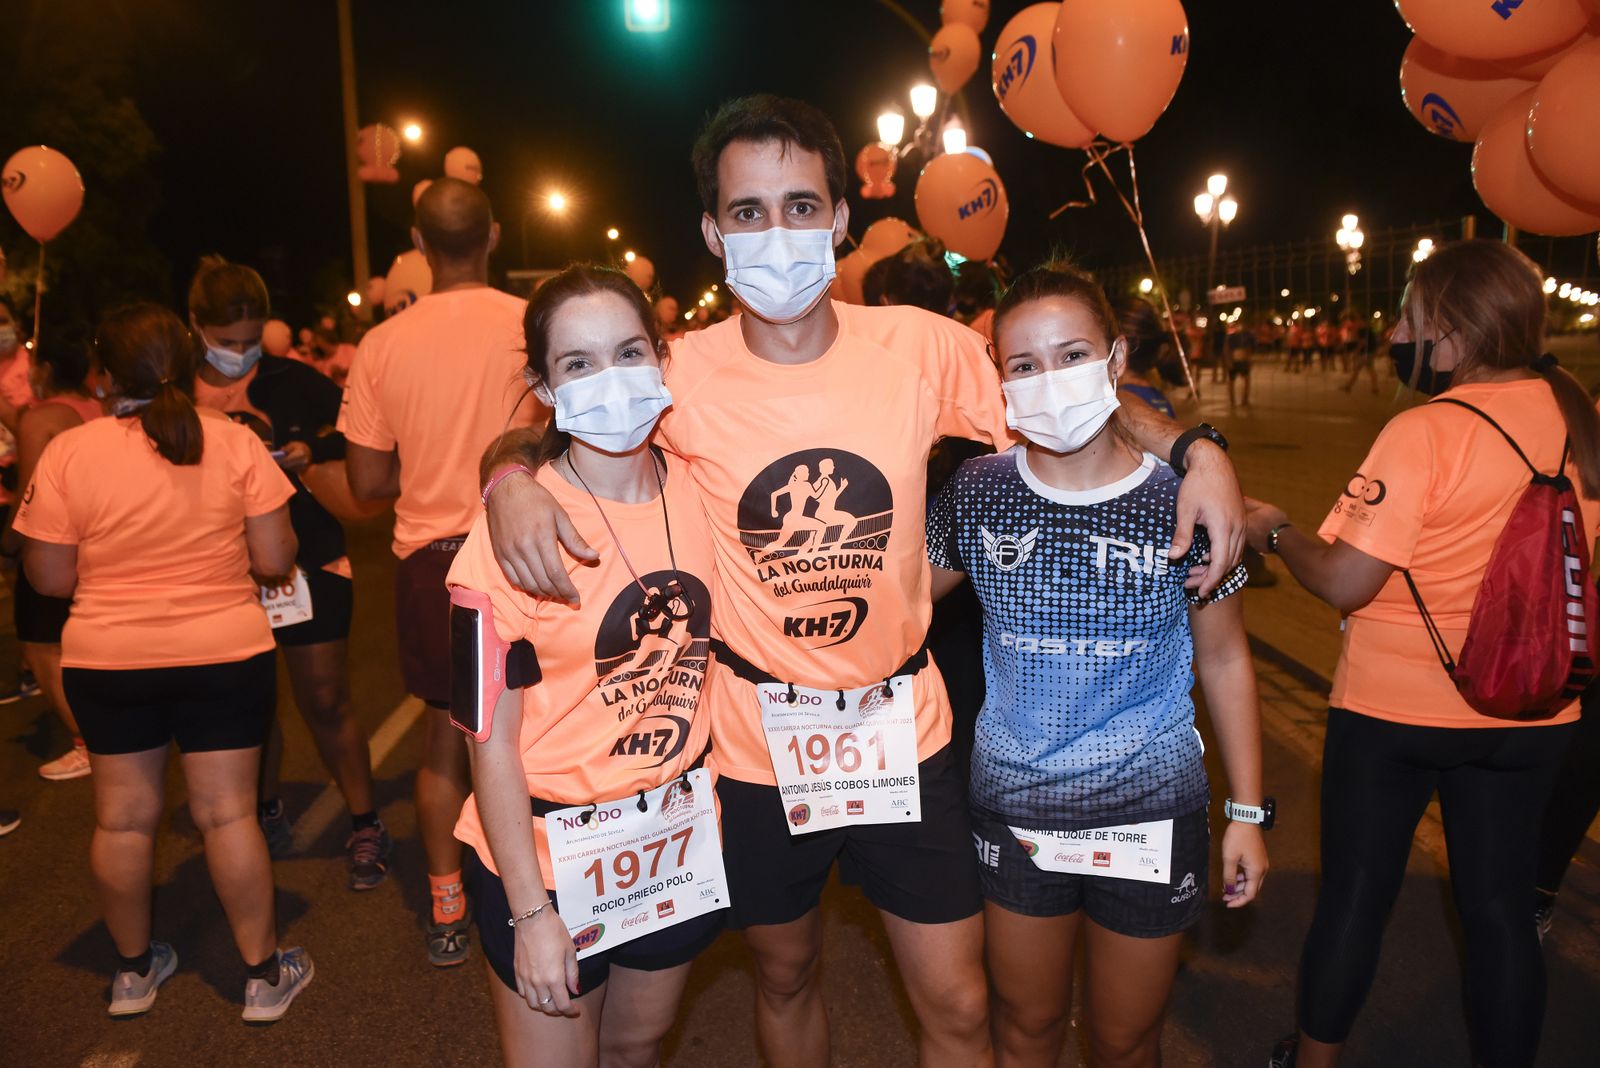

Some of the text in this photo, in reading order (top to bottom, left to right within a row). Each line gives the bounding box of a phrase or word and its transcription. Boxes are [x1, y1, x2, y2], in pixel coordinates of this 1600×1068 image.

[757, 554, 883, 583] LA NOCTURNA
[1089, 535, 1154, 575] TRI
[773, 574, 873, 598] del Guadalquivir
[600, 687, 628, 707] LA
[787, 730, 887, 776] 1961
[781, 776, 915, 796] ANTONIO JESÚS COBOS LIMONES
[577, 847, 606, 859] CARRERA
[606, 837, 640, 852] NOCTURNA
[640, 834, 652, 842] DEL
[1056, 830, 1091, 840] LUQUE
[1094, 831, 1108, 841] DE
[1112, 831, 1147, 844] TORRE
[584, 825, 694, 897] 1977
[592, 899, 626, 916] ROCIO
[628, 882, 664, 904] PRIEGO
[666, 871, 694, 889] POLO
